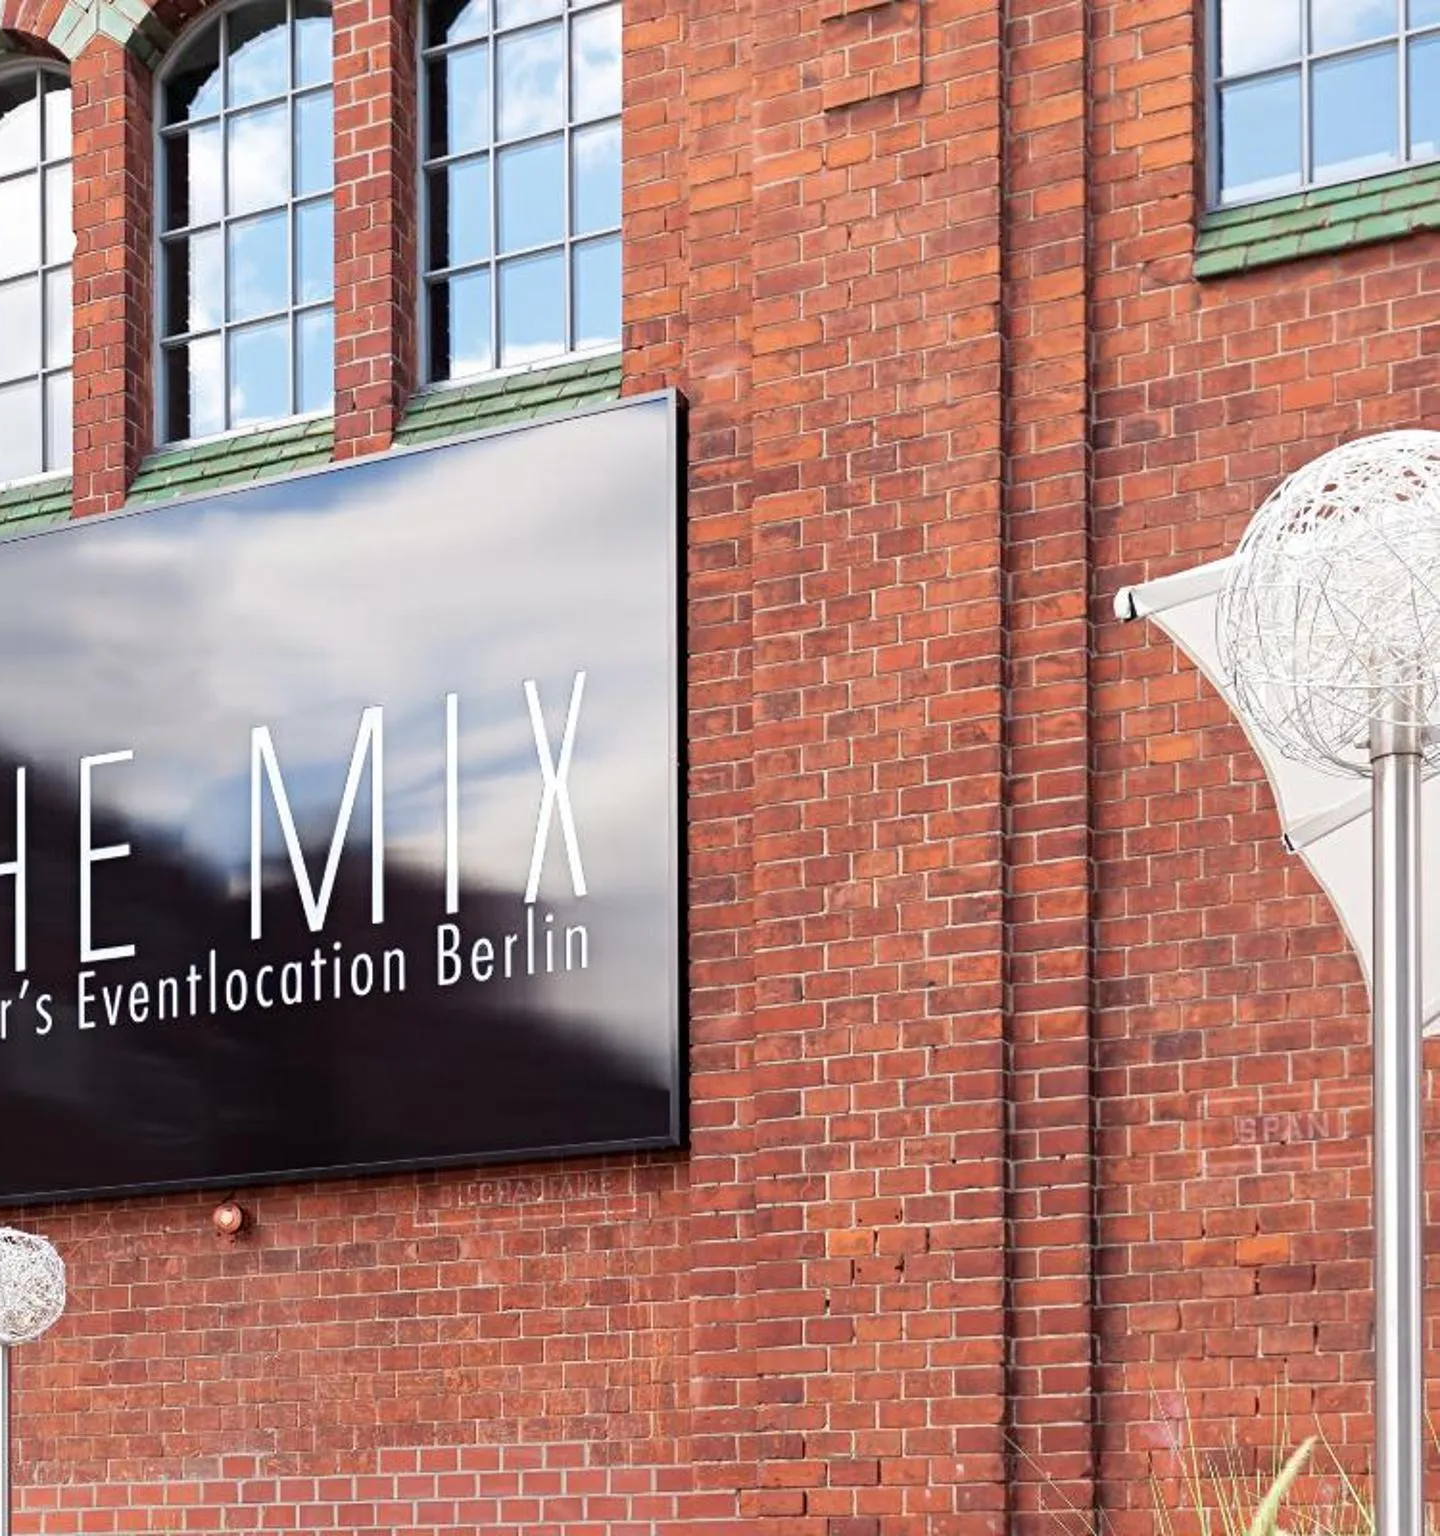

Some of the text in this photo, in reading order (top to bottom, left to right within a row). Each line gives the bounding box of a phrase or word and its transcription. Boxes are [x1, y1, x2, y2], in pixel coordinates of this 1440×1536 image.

[250, 670, 588, 941] MIX
[78, 943, 407, 1031] Eventlocation
[437, 903, 590, 987] Berlin
